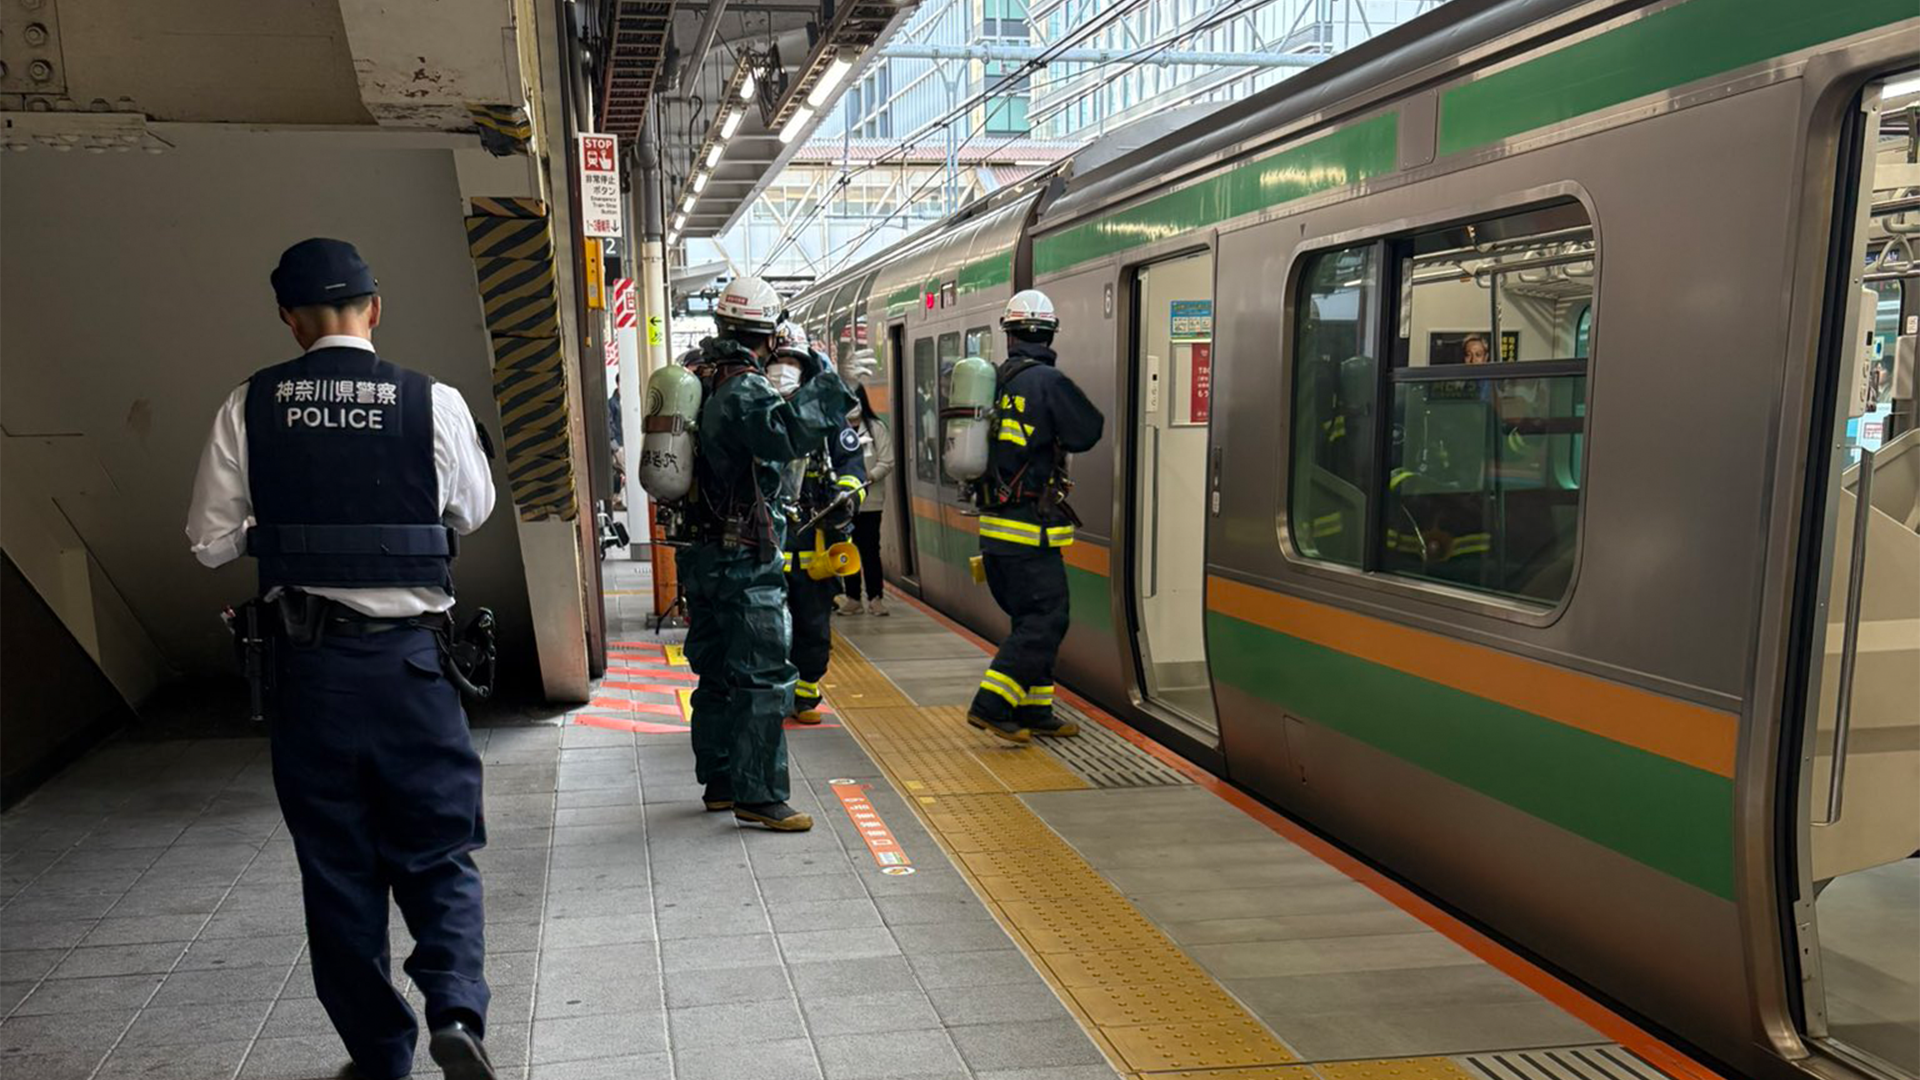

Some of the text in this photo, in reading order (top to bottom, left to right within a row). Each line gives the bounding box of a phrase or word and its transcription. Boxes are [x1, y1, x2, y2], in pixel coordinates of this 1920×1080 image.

[585, 139, 612, 149] STOP
[585, 174, 616, 185] 非常停止
[593, 185, 616, 196] ボタン
[605, 238, 616, 255] 2
[1105, 289, 1111, 314] 6
[276, 379, 397, 405] 神奈川県警察
[287, 407, 383, 429] POLICE
